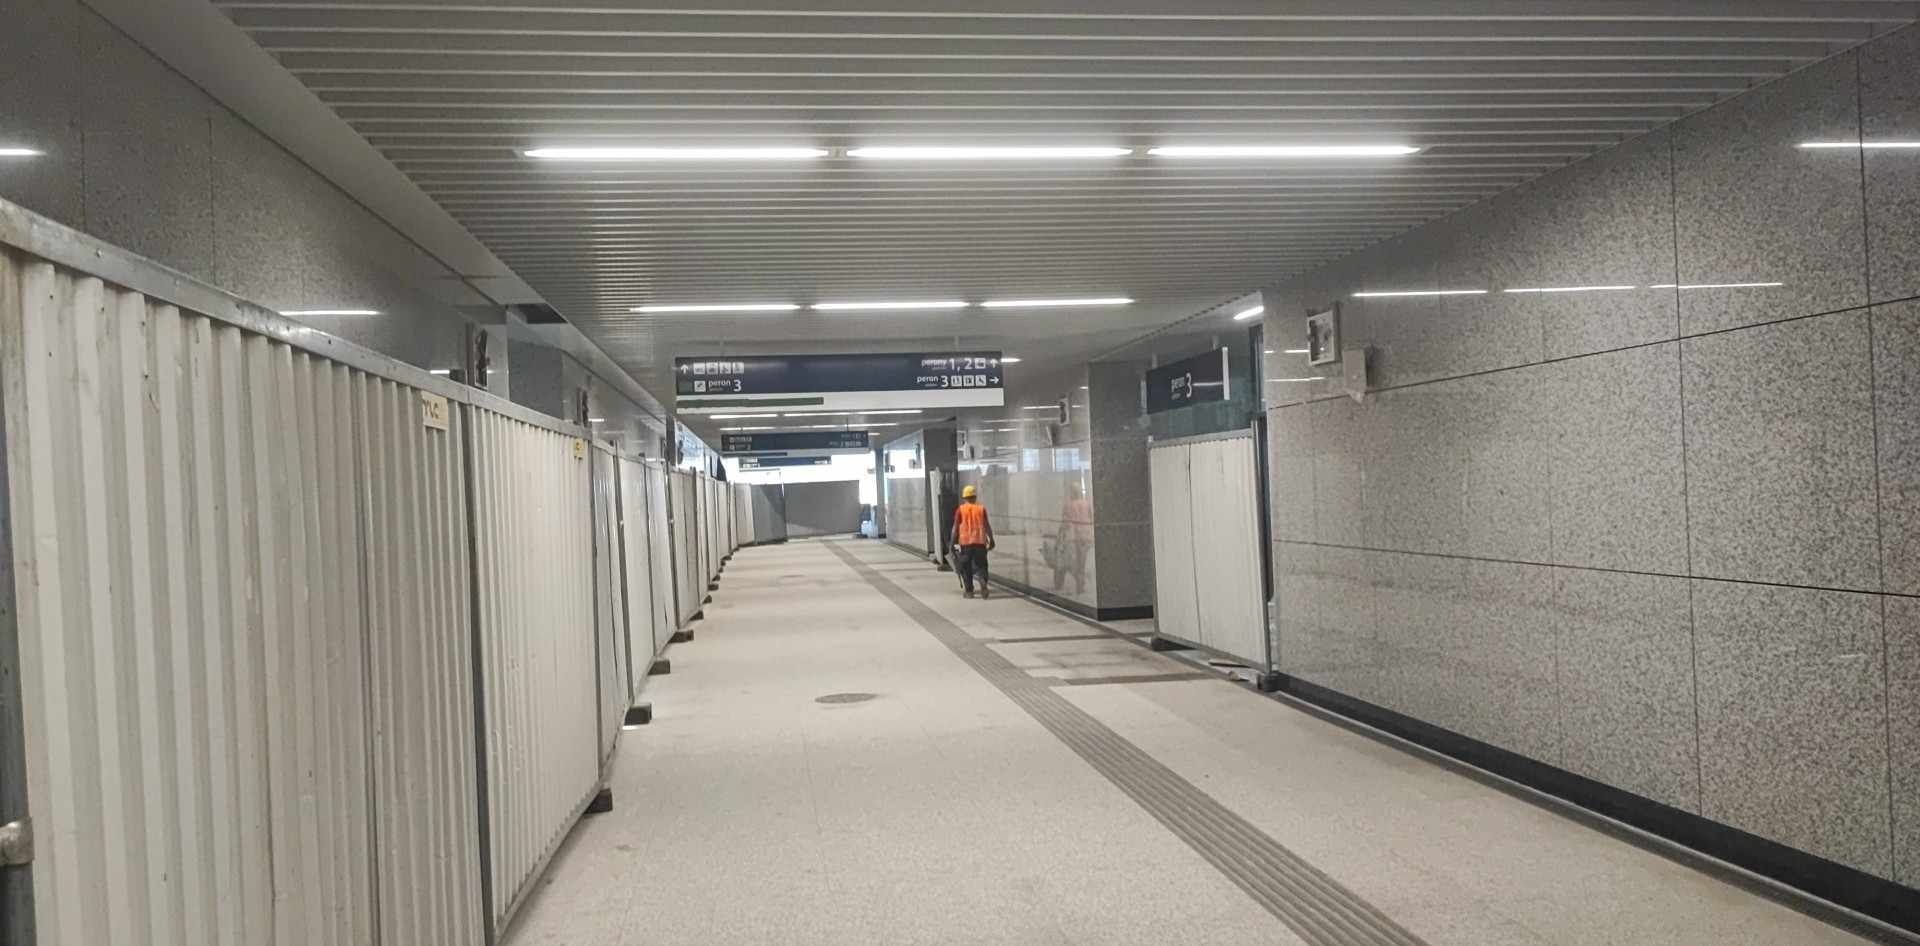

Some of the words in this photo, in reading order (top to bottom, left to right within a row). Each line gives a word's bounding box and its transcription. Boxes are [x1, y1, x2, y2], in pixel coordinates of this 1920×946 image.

[964, 358, 973, 369] 2
[708, 379, 731, 388] peron
[733, 379, 742, 392] 3
[917, 375, 939, 383] peron
[940, 375, 949, 388] 3
[1186, 373, 1192, 398] 3
